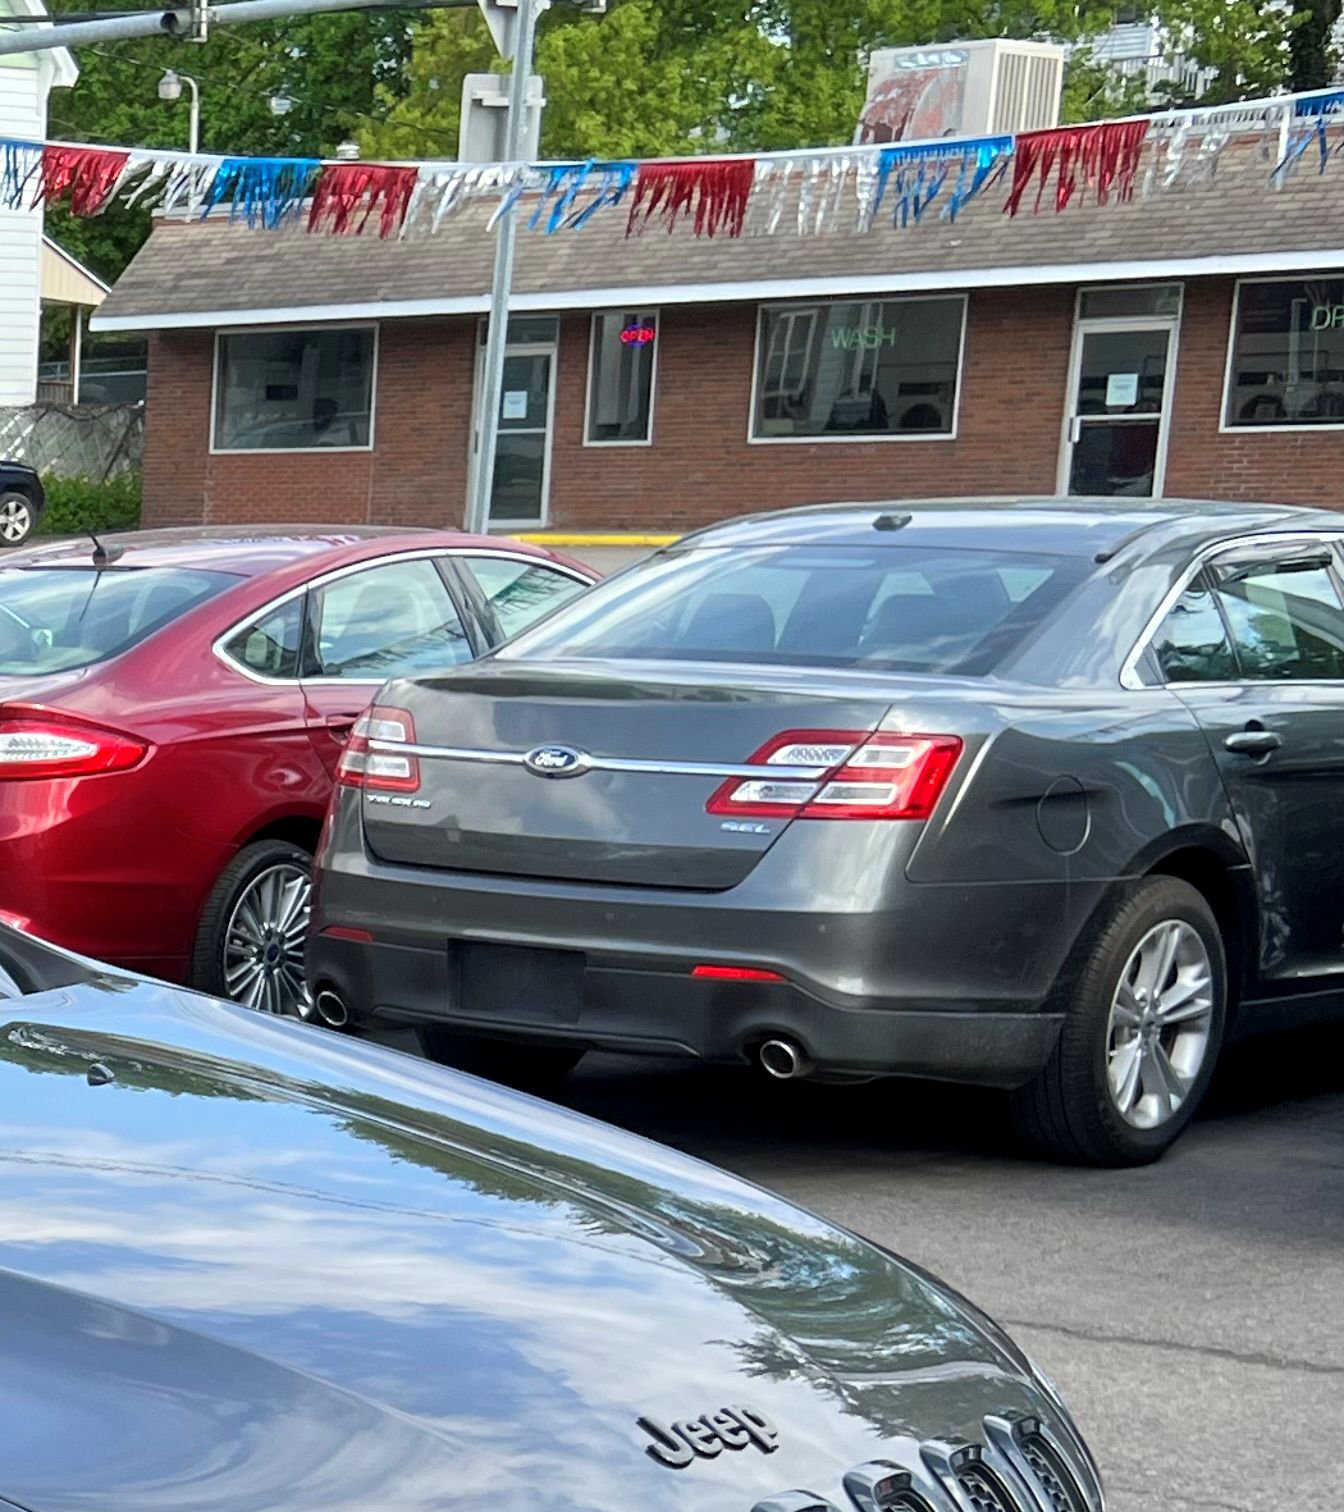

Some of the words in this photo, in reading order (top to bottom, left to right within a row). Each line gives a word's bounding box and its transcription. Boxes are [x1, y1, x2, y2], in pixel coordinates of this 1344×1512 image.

[620, 328, 655, 343] OPEN
[831, 327, 895, 349] WASH
[635, 1402, 780, 1470] Jeep
